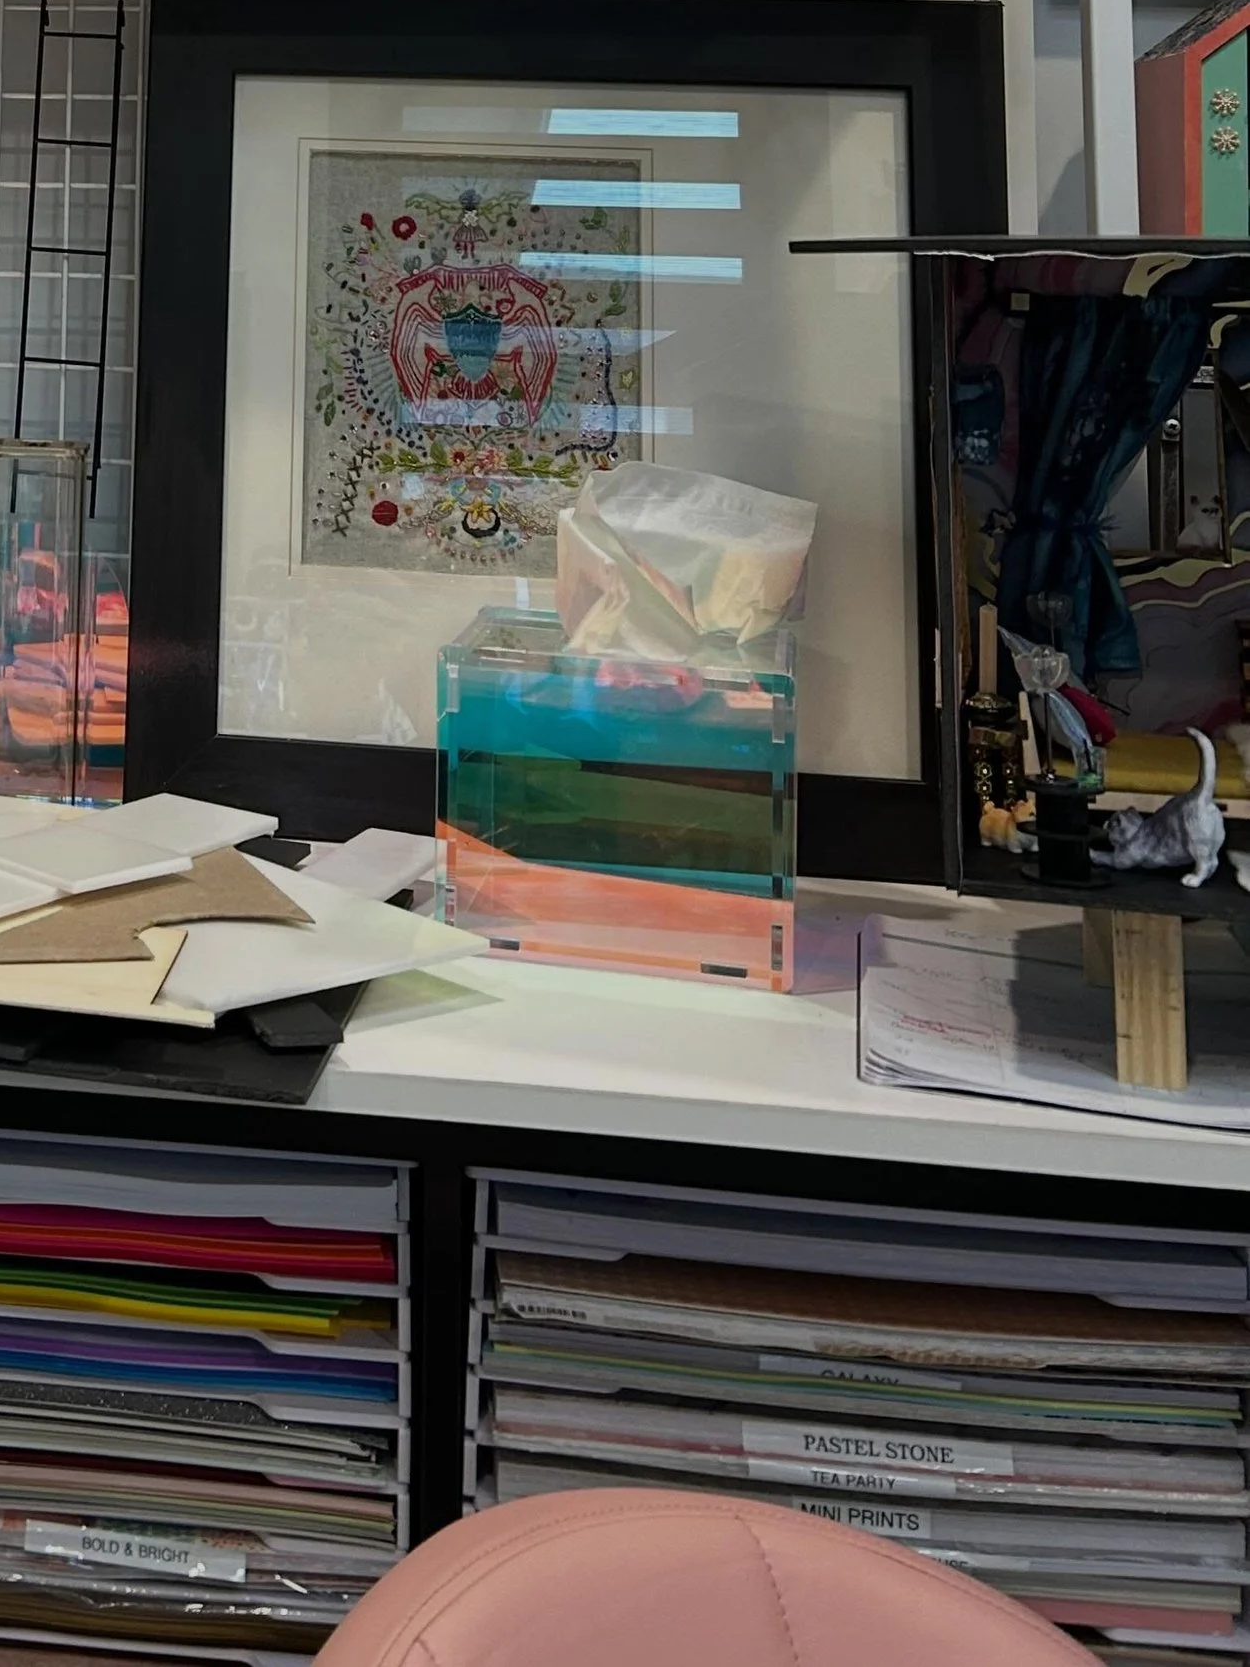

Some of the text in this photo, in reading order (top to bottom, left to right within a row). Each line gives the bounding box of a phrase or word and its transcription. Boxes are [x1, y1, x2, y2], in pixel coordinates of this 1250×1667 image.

[803, 1434, 955, 1464] PASTEL STONE
[811, 1469, 897, 1490] TEA PARTY
[848, 1507, 920, 1531] PRINTS
[81, 1536, 190, 1564] BOLD & BRIGHT
